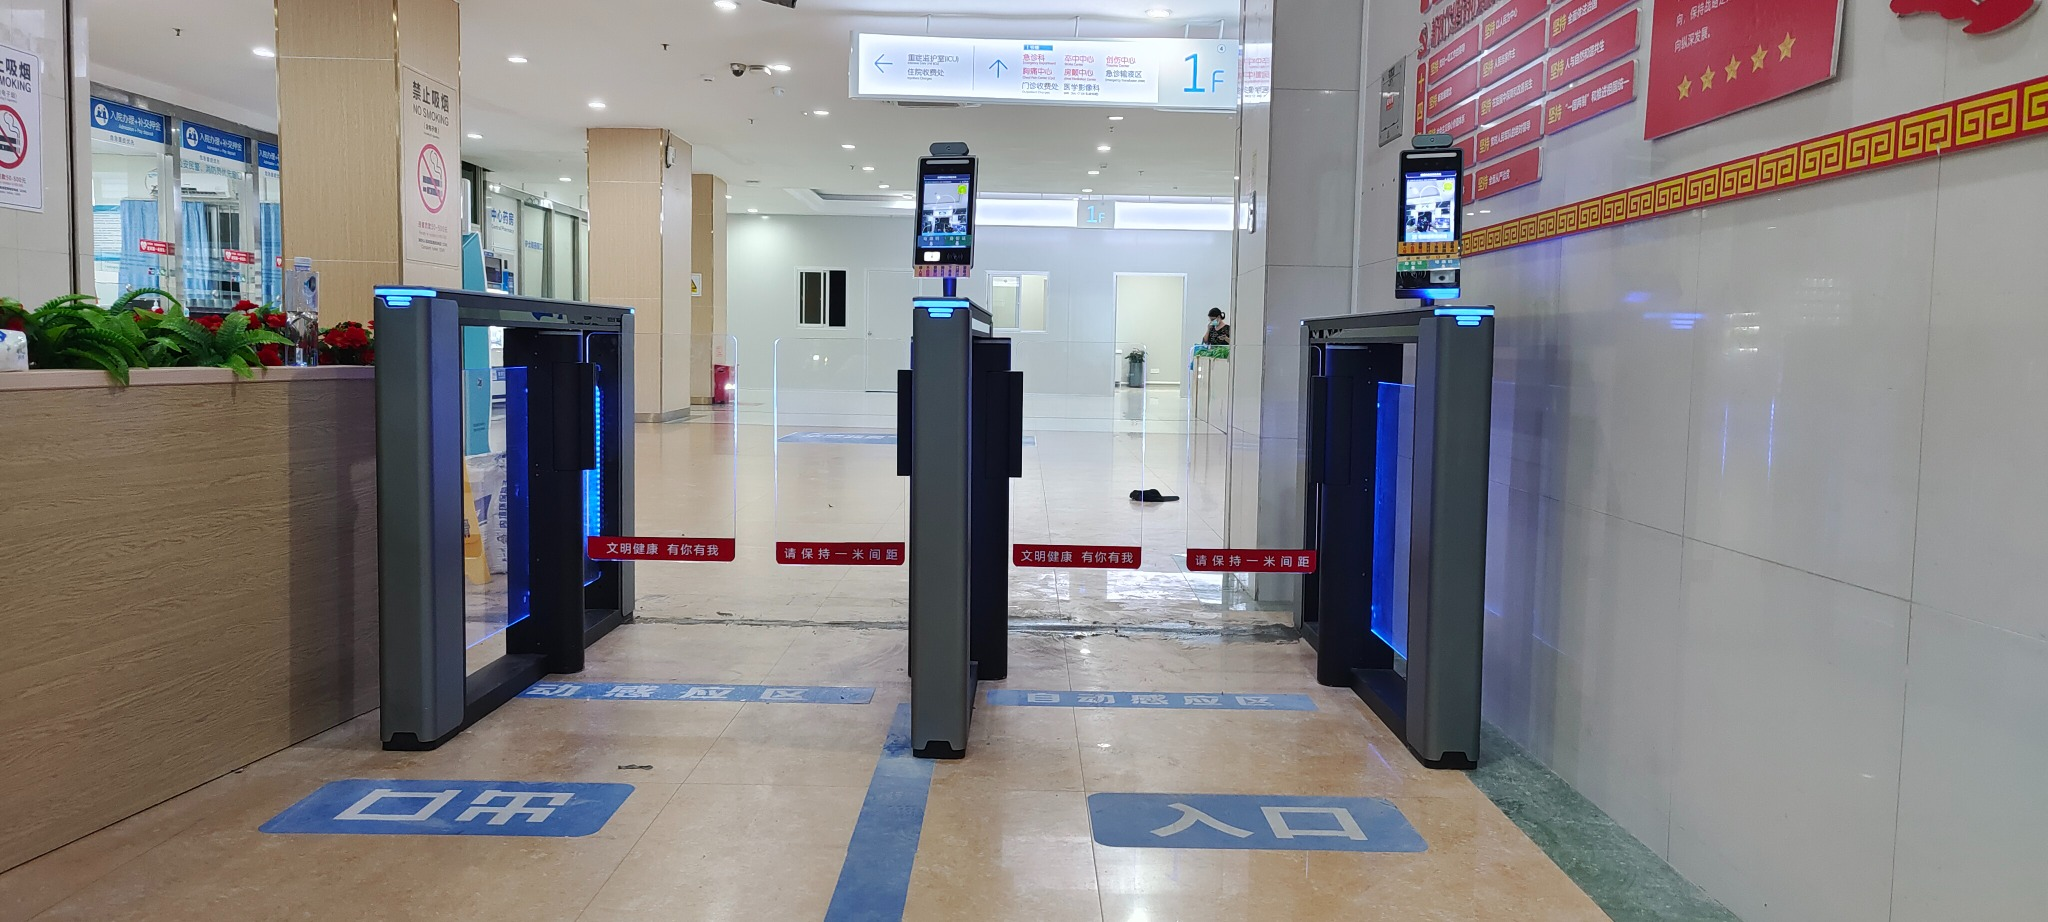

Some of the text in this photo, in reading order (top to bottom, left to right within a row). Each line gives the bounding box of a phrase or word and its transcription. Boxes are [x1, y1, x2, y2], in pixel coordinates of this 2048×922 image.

[1022, 53, 1045, 61] 急诊科
[1105, 56, 1136, 64] 创伤中心
[0, 57, 32, 82] 吸烟
[907, 68, 944, 77] 住院收费处
[1550, 58, 1564, 80] 坚持
[1021, 81, 1059, 90] 门诊收费处
[1063, 83, 1100, 92] 医学影像科
[412, 80, 449, 113] 禁止吸烟
[413, 103, 449, 127] NO SMOKING
[1548, 103, 1562, 125] 坚持
[491, 207, 514, 226] 中心药房
[1087, 205, 1105, 223] 1F
[606, 541, 719, 557] 文明健康 有你有我
[783, 547, 899, 561] 请保持一米间距
[1020, 549, 1134, 565] 文明健康 有你有我
[1195, 554, 1310, 568] 请保持一米间距
[525, 683, 810, 701] 动感应区
[1027, 692, 1276, 708] 自动感应区
[333, 788, 577, 826] 出口
[1149, 802, 1370, 842] 入口
